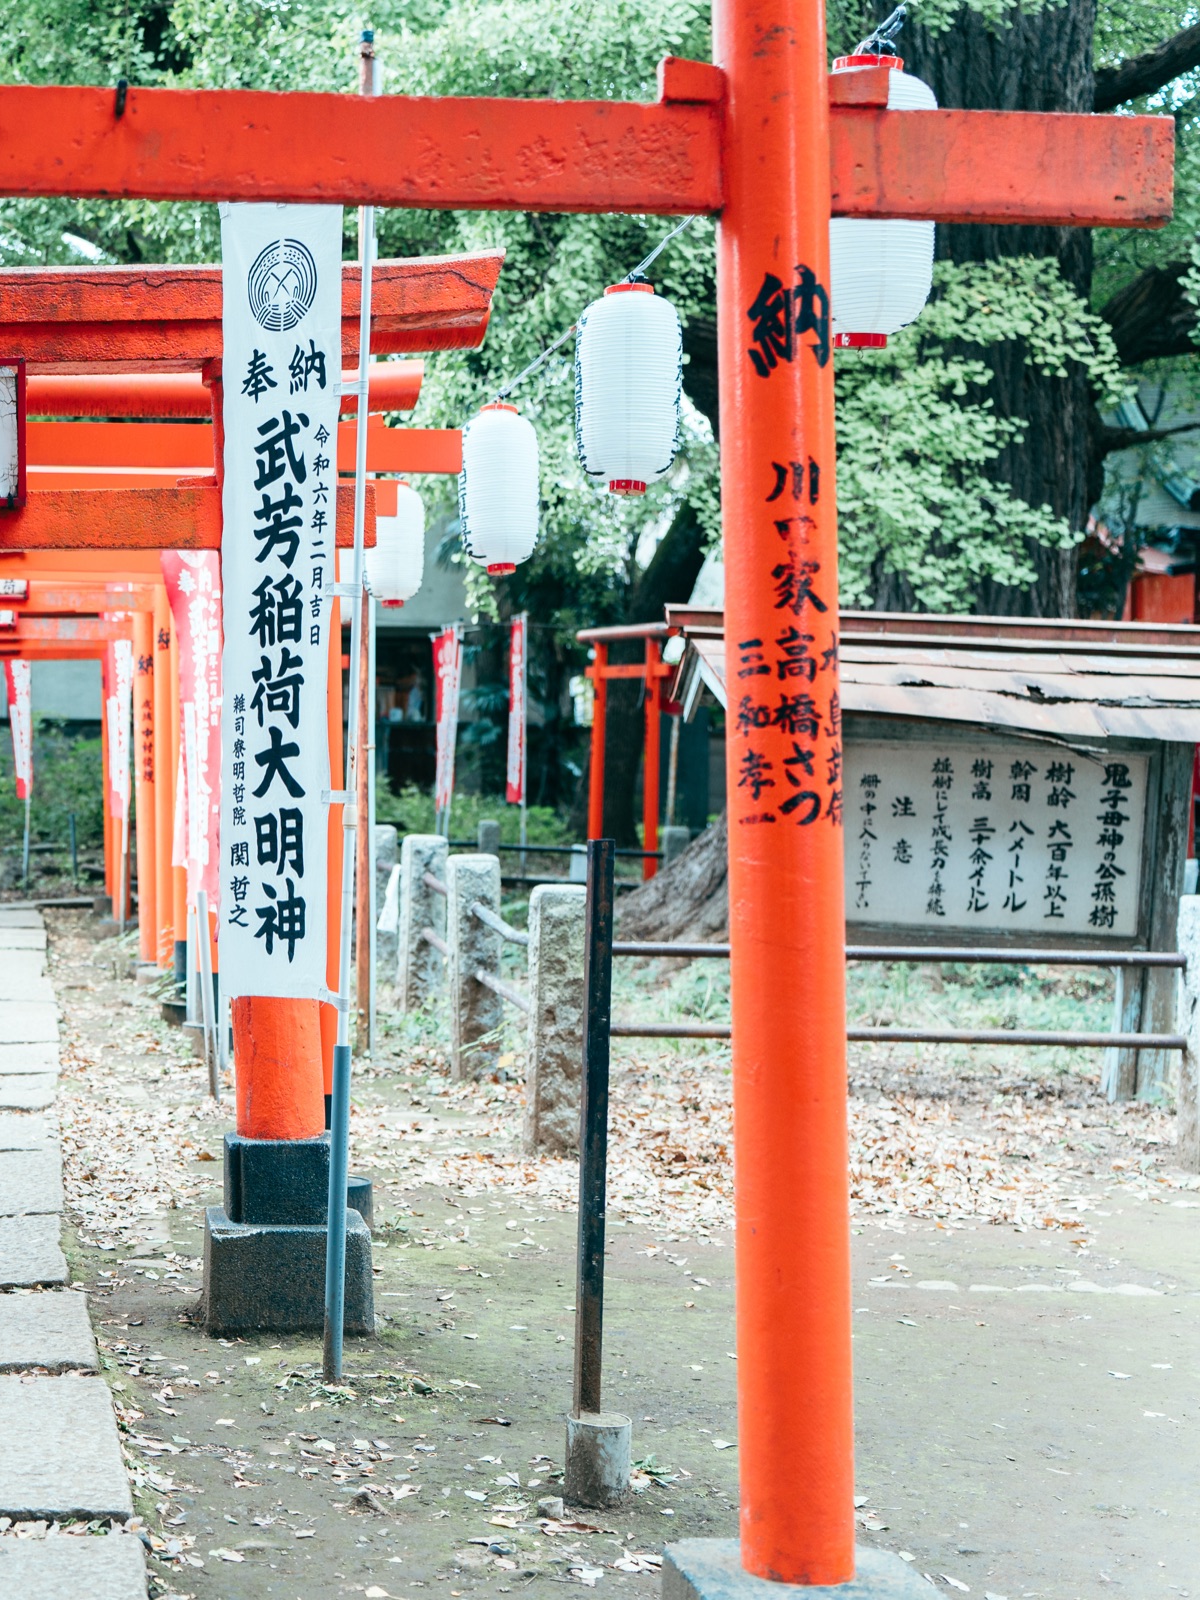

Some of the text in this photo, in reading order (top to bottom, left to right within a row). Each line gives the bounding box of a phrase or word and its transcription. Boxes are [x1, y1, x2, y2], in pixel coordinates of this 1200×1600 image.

[240, 338, 327, 404] 奉納
[747, 263, 832, 379] 納
[309, 423, 331, 647] 令和六年二月吉日
[249, 410, 310, 964] 武芳稲荷大明神
[771, 625, 823, 826] 高橋さつ
[890, 797, 917, 864] 注意
[970, 759, 994, 802] 樹高
[1002, 760, 1038, 913] 幹周 八メートル
[1044, 761, 1077, 809] 樹齢
[228, 841, 251, 928] 関哲之
[1088, 763, 1132, 929] 鬼子母神の公孫樹
